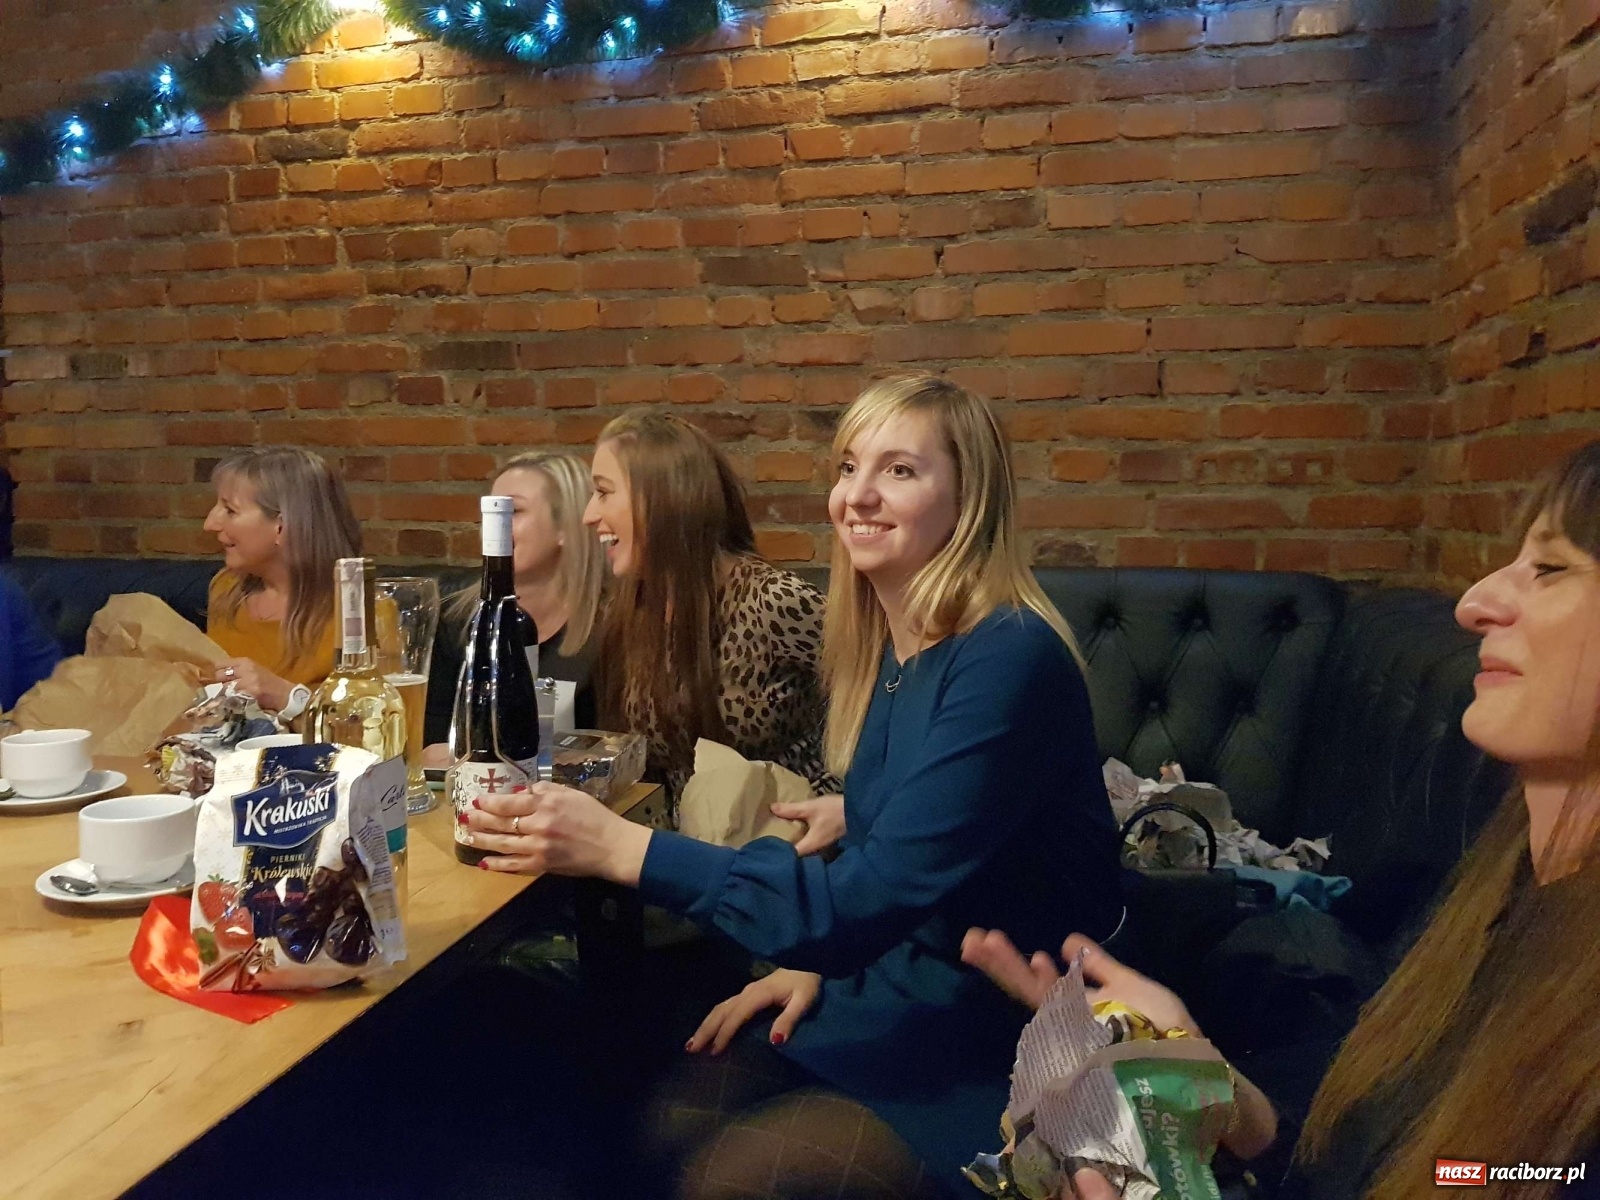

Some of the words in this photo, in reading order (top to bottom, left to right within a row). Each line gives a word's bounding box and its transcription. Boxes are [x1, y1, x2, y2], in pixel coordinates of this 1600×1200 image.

[243, 787, 330, 836] Krakuski
[270, 854, 306, 863] PIERNIKI
[1135, 1078, 1157, 1137] ujesz
[1161, 1112, 1194, 1200] otówki?
